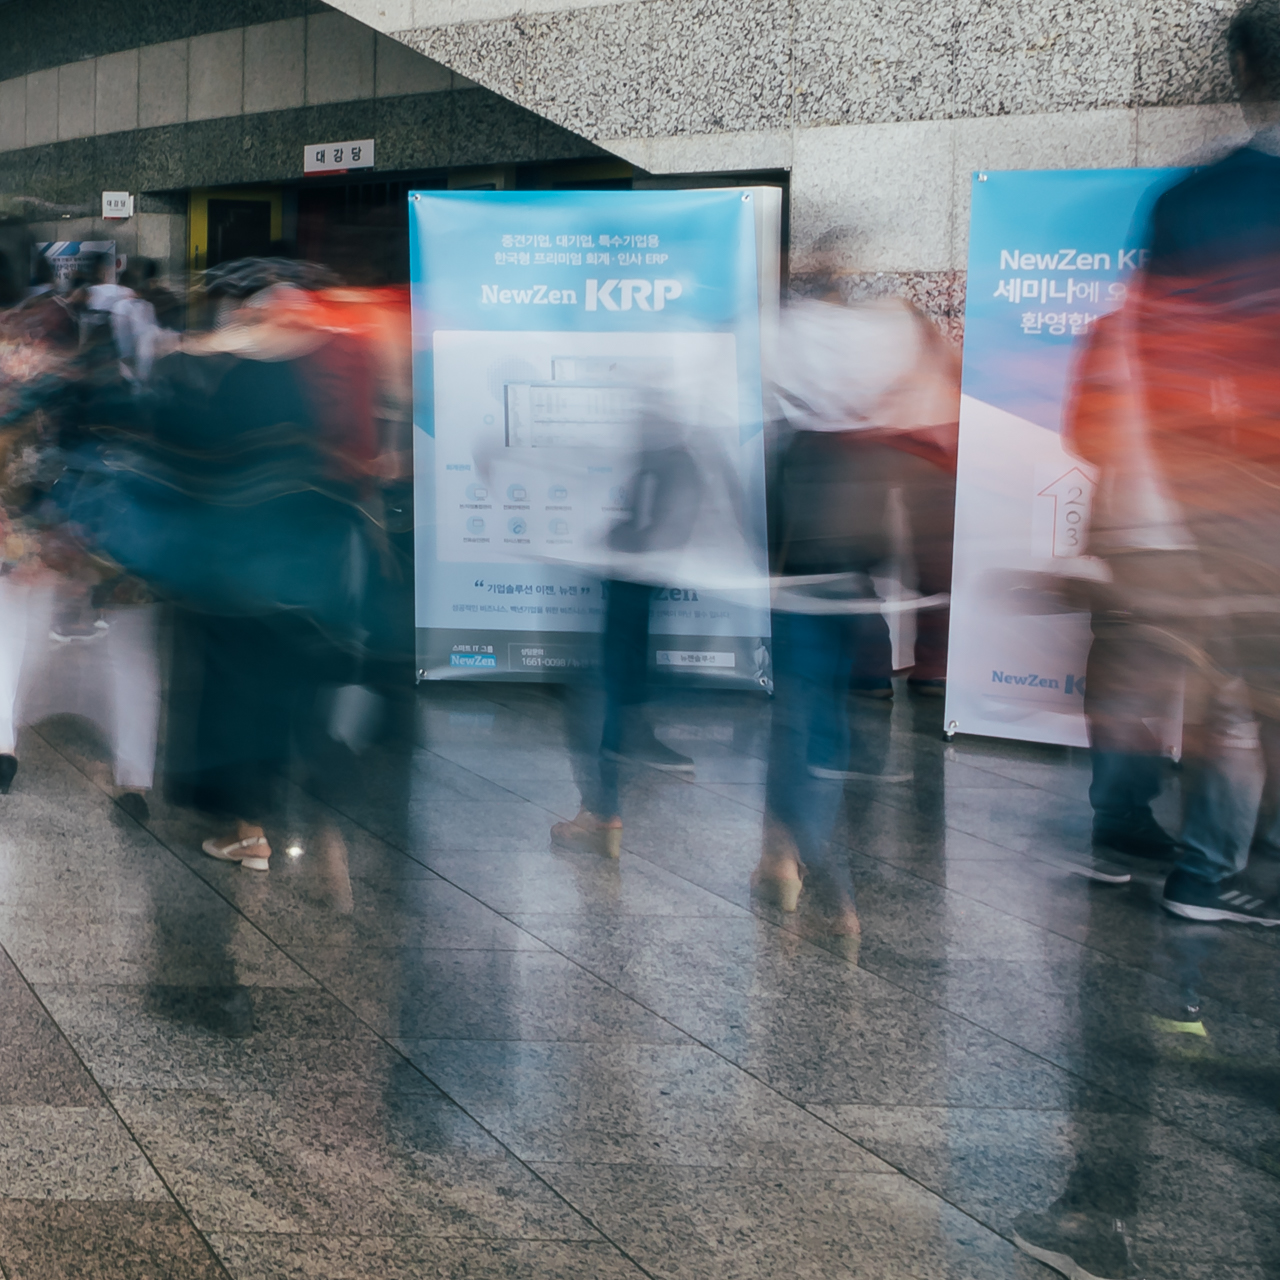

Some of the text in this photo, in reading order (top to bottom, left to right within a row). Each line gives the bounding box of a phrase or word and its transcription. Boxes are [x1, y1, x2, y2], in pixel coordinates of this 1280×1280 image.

[315, 145, 363, 164] 대강당
[501, 234, 661, 249] 중견기업, 대기업, 특수기업용
[494, 252, 530, 266] 한국형
[533, 252, 582, 266] 프리미엄
[645, 253, 669, 265] ERP
[999, 248, 1112, 271] NewZen
[481, 278, 684, 313] NewZen KRP
[992, 277, 1100, 304] 세미나에
[1065, 486, 1086, 547] 203
[487, 584, 533, 595] 기업솔루션
[451, 655, 496, 666] NewZen
[521, 657, 566, 667] 1661-0098
[991, 670, 1060, 690] NewZen
